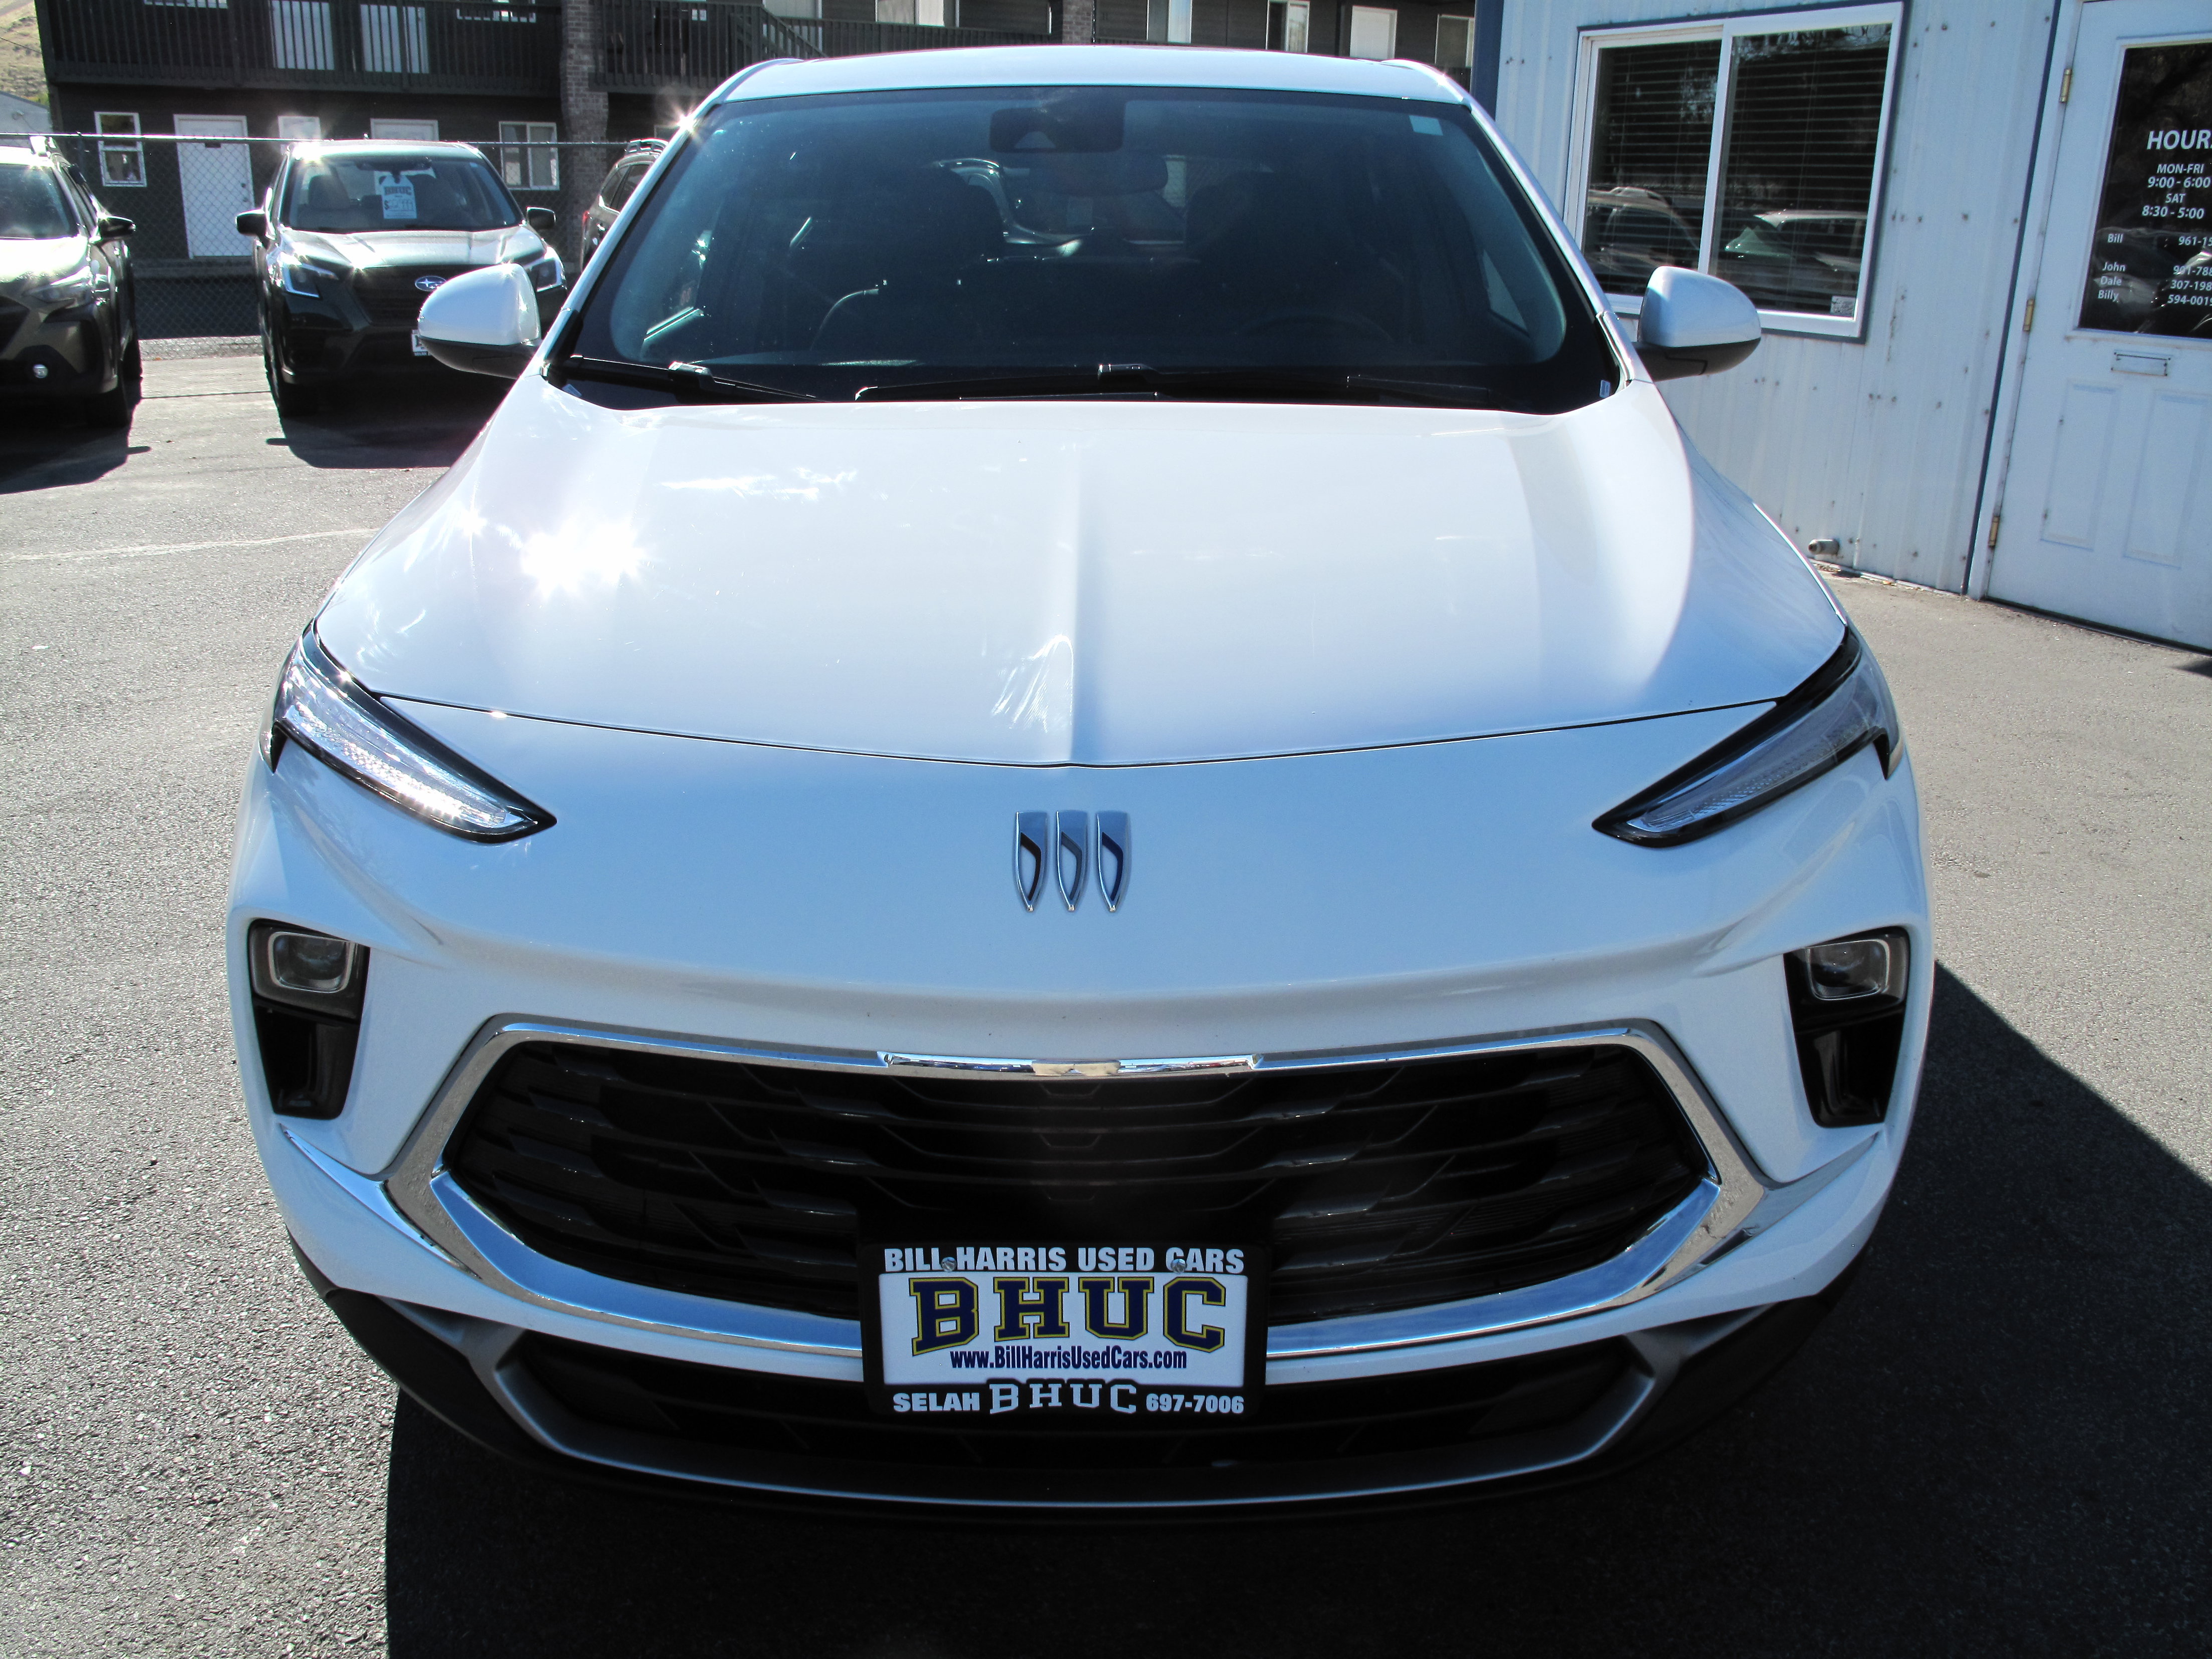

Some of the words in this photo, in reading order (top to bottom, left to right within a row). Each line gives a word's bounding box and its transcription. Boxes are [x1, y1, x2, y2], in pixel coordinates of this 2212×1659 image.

[2146, 130, 2212, 149] HOUR
[2157, 164, 2204, 173] MON-FRI
[2147, 176, 2174, 188] 9:00
[2183, 177, 2211, 188] 6:00
[2165, 193, 2186, 203] SAT
[2142, 205, 2168, 216] 8:30
[2177, 207, 2204, 219] 5:00
[2107, 233, 2124, 243] Bill
[2102, 262, 2126, 271] John
[2101, 276, 2122, 286] Dale
[2098, 290, 2119, 302] Billy
[885, 1248, 944, 1272] BILL
[956, 1247, 1066, 1271] HARRIS
[1078, 1247, 1155, 1272] USED
[1166, 1247, 1244, 1274] CARS
[909, 1276, 1226, 1356] BHUC
[950, 1345, 1187, 1369] www.BillHarrisUsedCars.com
[893, 1393, 980, 1412] SELAH
[989, 1384, 1137, 1414] BHUC
[1146, 1393, 1244, 1414] 697-7006
